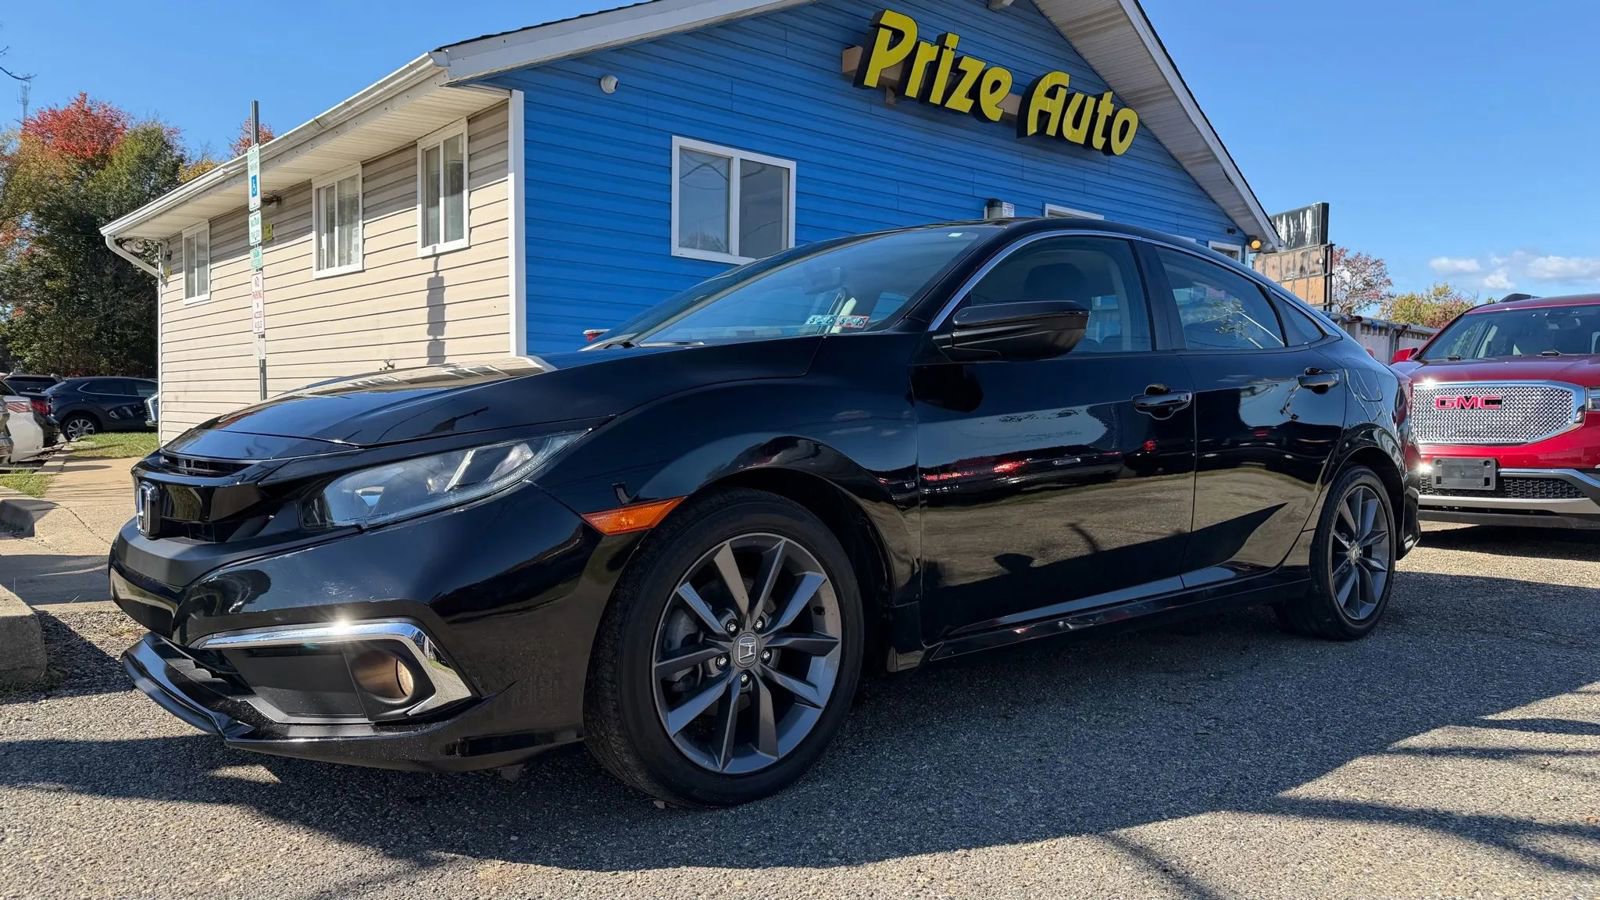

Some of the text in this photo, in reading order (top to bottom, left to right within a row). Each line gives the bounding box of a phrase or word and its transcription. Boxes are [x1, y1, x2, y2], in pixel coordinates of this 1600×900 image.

[863, 9, 1139, 156] Prize Auto
[1435, 394, 1503, 411] GMC
